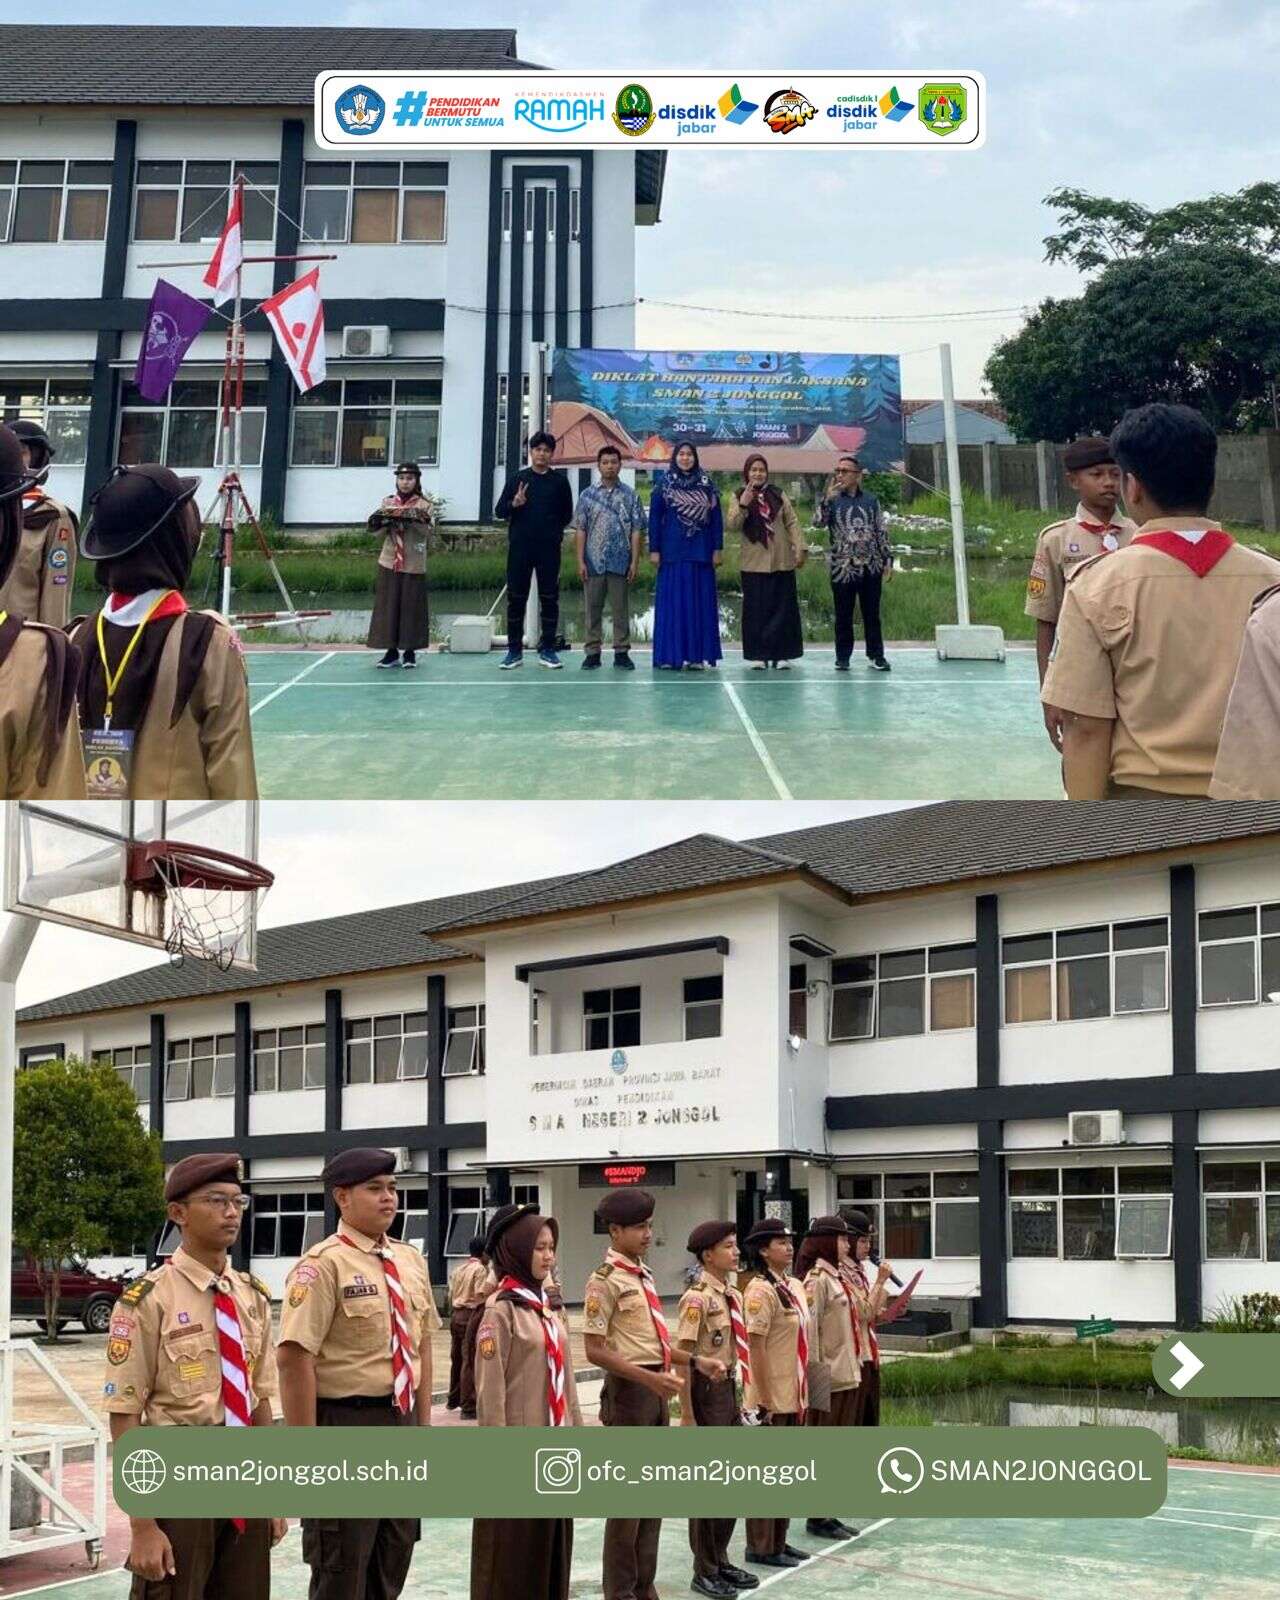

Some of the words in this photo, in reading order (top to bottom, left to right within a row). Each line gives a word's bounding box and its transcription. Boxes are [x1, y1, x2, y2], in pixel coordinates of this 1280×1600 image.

[591, 371, 656, 382] DIKLAT
[652, 388, 705, 399] SMAN
[672, 422, 707, 433] 30-31
[637, 1110, 648, 1126] 2
